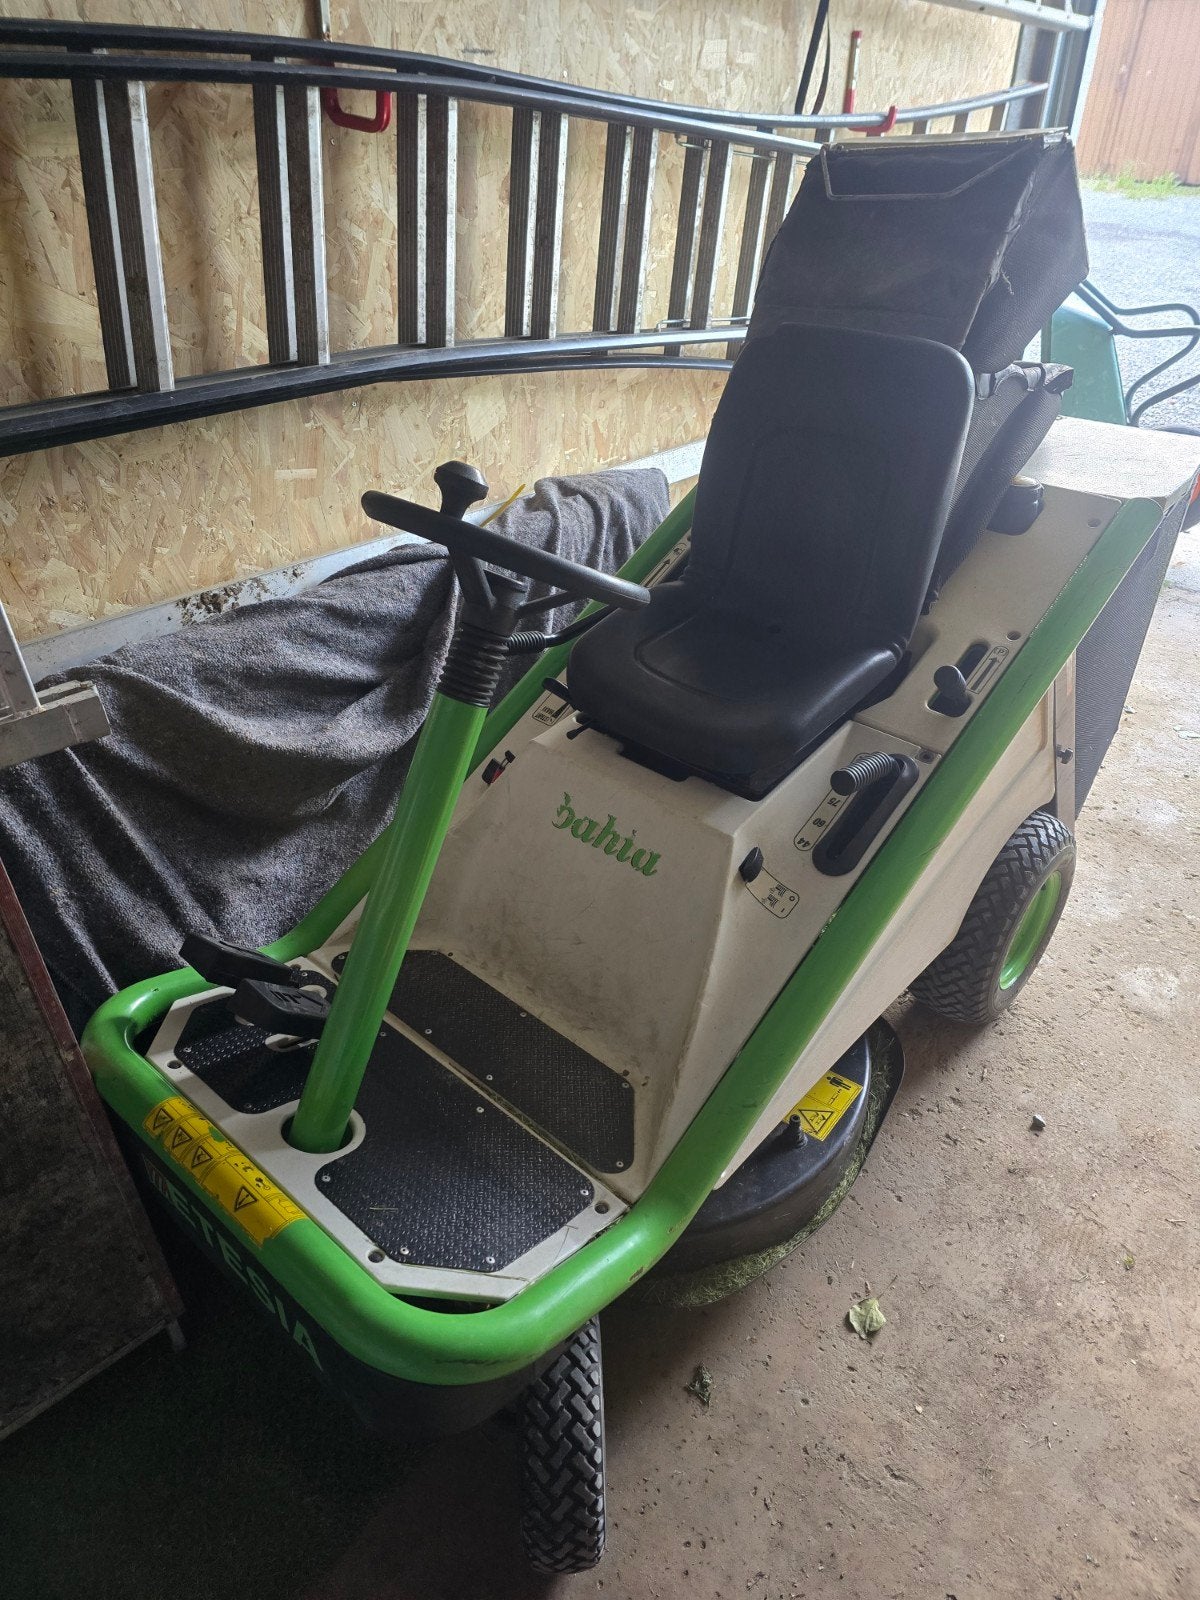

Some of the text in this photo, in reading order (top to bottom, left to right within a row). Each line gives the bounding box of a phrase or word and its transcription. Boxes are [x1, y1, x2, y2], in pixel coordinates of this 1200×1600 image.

[827, 797, 841, 807] 75
[812, 817, 827, 828] 60
[797, 837, 811, 848] 44
[166, 1180, 323, 1372] ETESIA
